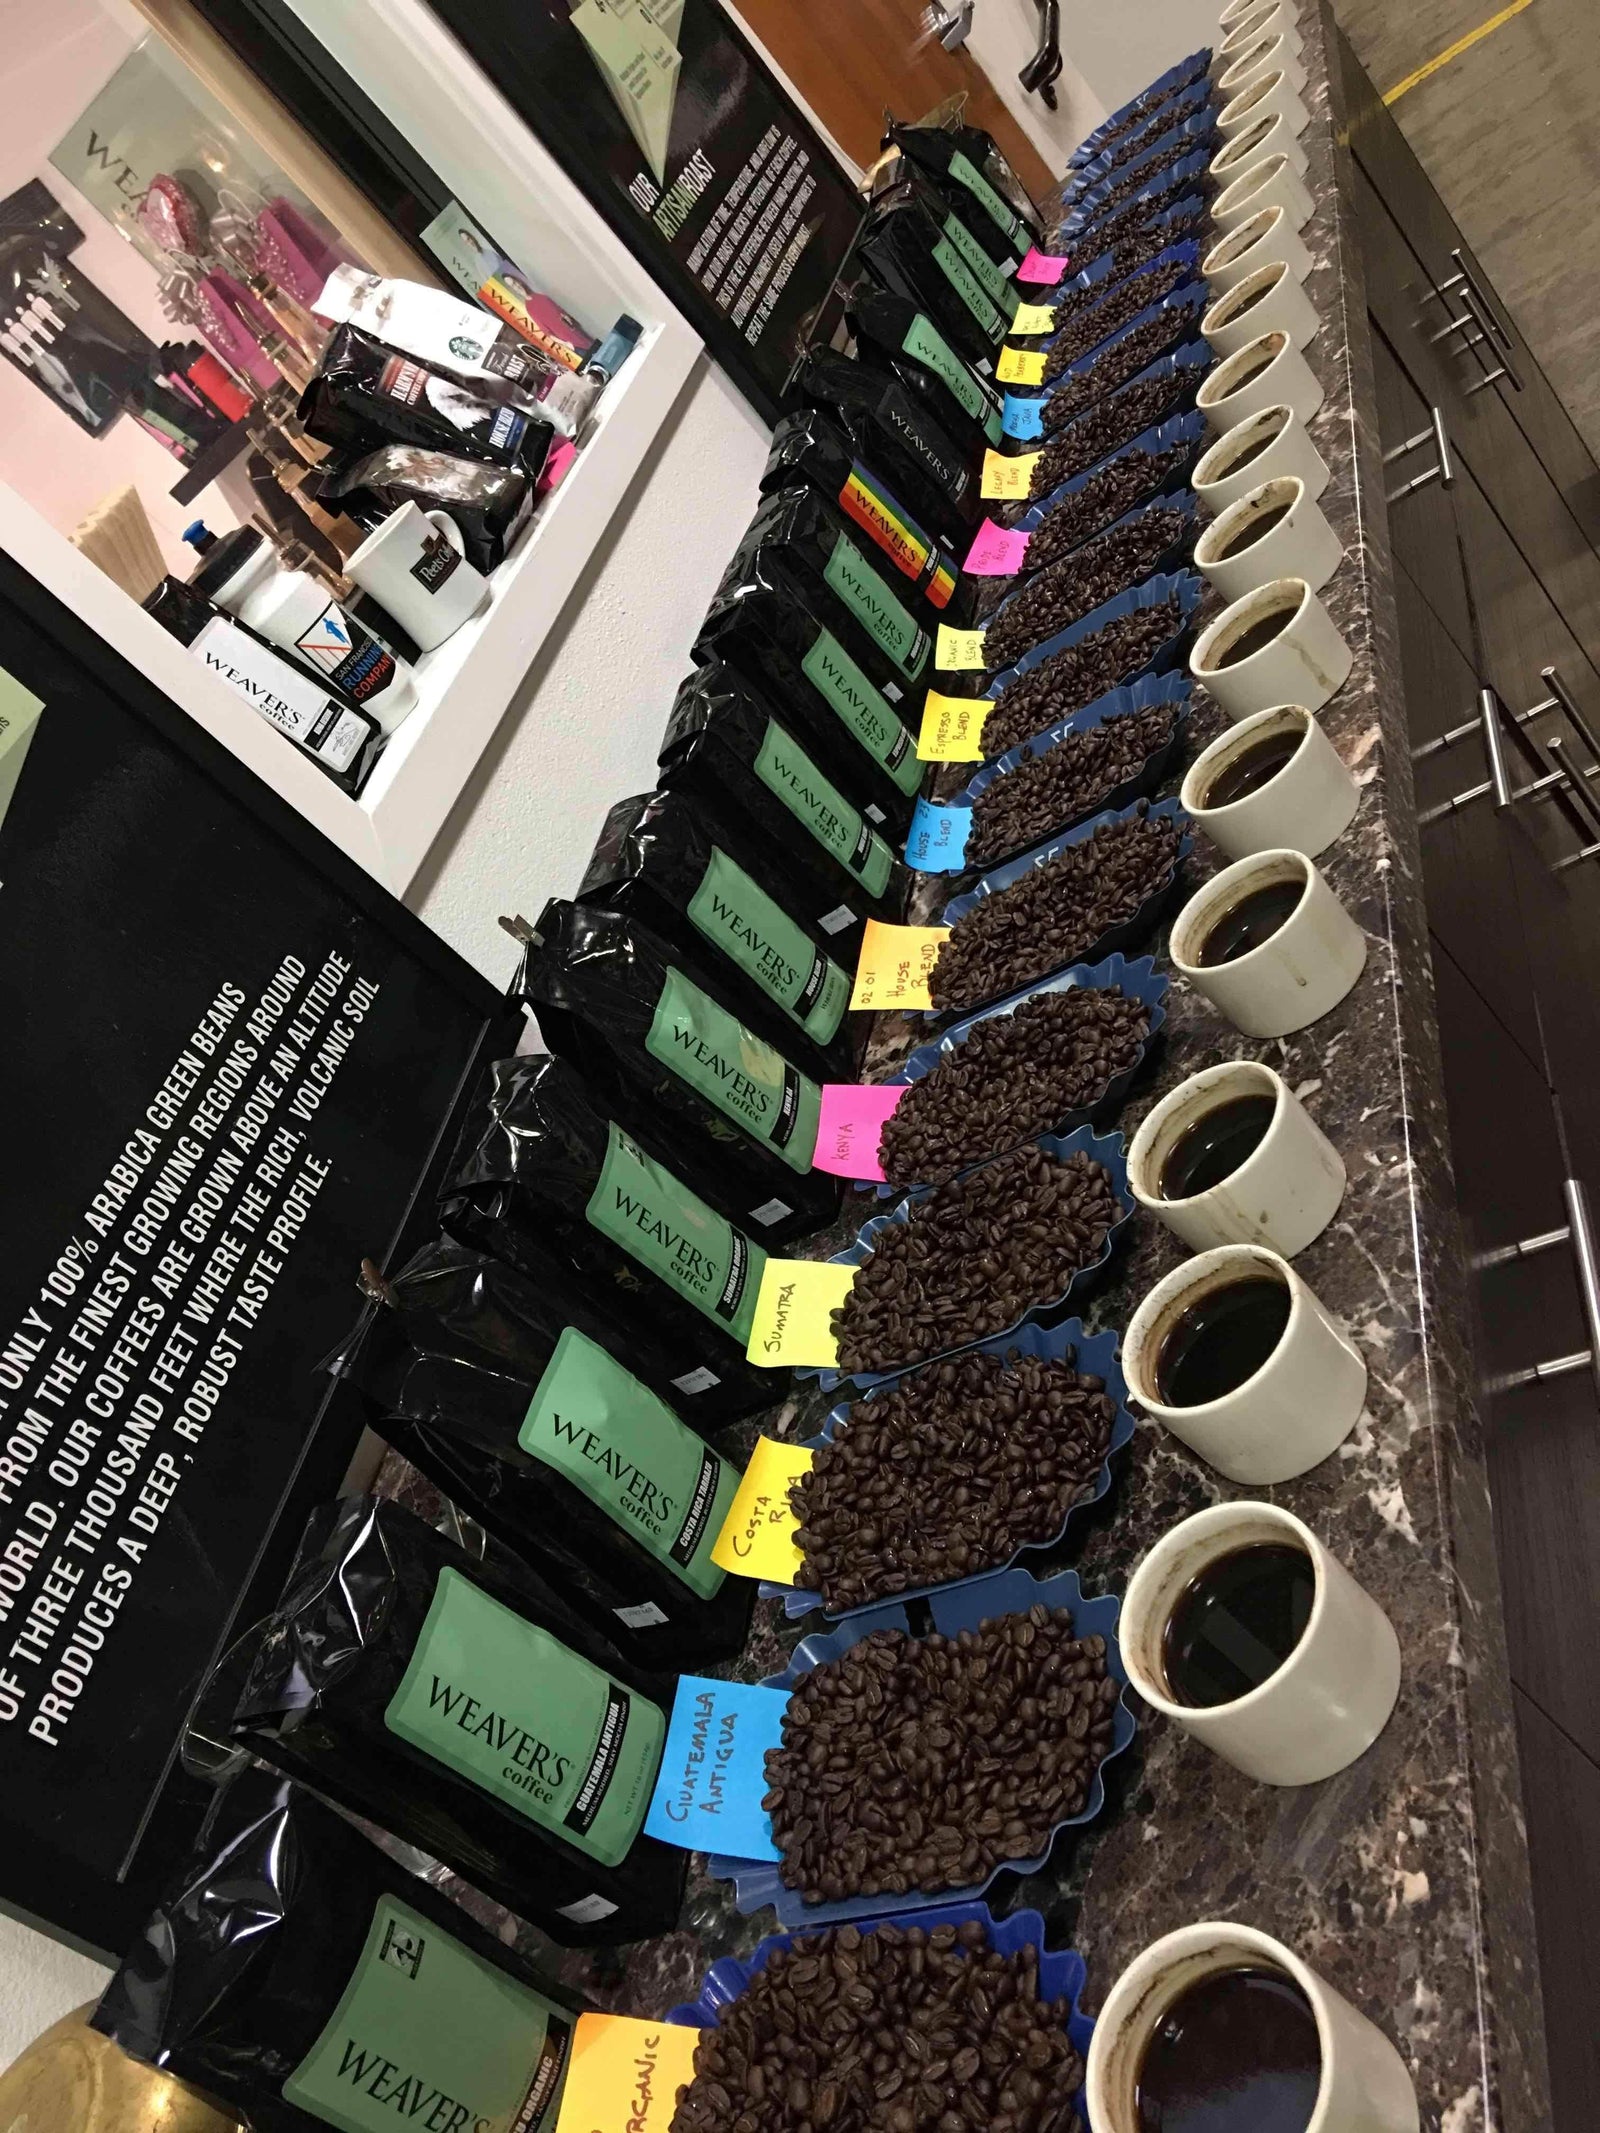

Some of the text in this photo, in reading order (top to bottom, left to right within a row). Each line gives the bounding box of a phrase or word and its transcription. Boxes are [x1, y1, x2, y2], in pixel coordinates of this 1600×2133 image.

[629, 172, 660, 213] OUR
[653, 148, 716, 242] ARTISANROAST
[742, 200, 757, 223] THE
[749, 172, 773, 212] POTENTIAL
[728, 211, 750, 247] UNLOCKS
[758, 198, 781, 235] BETWEEN
[716, 237, 735, 266] ROAST
[740, 224, 766, 268] DIFFERENCE
[784, 239, 801, 269] EVERY
[701, 268, 717, 292] HOW
[709, 256, 724, 279] OUR
[726, 269, 742, 291] THE
[730, 283, 757, 329] AUTOMATED
[766, 234, 783, 261] USED
[733, 257, 748, 279] KEY
[771, 257, 792, 295] PROCESS
[715, 287, 731, 311] THIS
[756, 300, 771, 325] THE
[762, 282, 780, 312] SAME
[744, 313, 765, 348] REPEAT
[504, 354, 527, 379] ROAST
[856, 490, 920, 563] WEAVER'S
[841, 565, 905, 645] WEAVER'S
[965, 639, 977, 662] BLEND
[205, 652, 304, 725] WEAVER'S
[335, 664, 352, 681] SAN
[259, 703, 295, 730] coffee
[821, 655, 889, 742] WEAVER'S
[855, 715, 880, 748] coffee
[930, 711, 951, 755] ESPRESSO
[952, 711, 971, 742] BLEND
[774, 757, 849, 843] WEAVER'S
[814, 817, 844, 849] coffee
[911, 831, 930, 861] HOUSE
[934, 818, 952, 848] BLEND
[711, 894, 800, 987] WEAVER'S
[756, 961, 788, 996] coffee
[805, 973, 818, 996] HOUSE
[886, 961, 911, 999] HOUSE
[911, 943, 936, 992] BLEND
[673, 1025, 773, 1114] WEAVER'S
[726, 1090, 763, 1125] coffee
[782, 1095, 793, 1116] KENYA
[830, 1122, 853, 1162] KENYA
[0, 982, 245, 1389] ONLY 100% ARABICA GREEN BEANS
[34, 1347, 86, 1406] THE
[69, 1252, 137, 1351] FINEST
[124, 1137, 204, 1255] GROWING
[189, 1040, 257, 1140] REGIONS
[246, 955, 305, 1045] AROUND
[49, 1419, 102, 1486] OUR
[86, 1297, 165, 1417] COFFEES
[151, 1240, 195, 1299] ARE
[180, 1148, 244, 1243] GROWN
[230, 1075, 283, 1154] ABOVE
[270, 1043, 300, 1082] AN
[288, 950, 350, 1050] ALTITUDE
[615, 1186, 720, 1284] WEAVER'S
[670, 1259, 708, 1296] coffee
[722, 1265, 739, 1303] SUMATRA
[764, 1283, 796, 1353] SUMATRA
[0, 1667, 26, 1720] OF
[14, 1556, 84, 1664] THREE
[64, 1394, 163, 1553] THOUSAND
[149, 1322, 198, 1393] FEET
[183, 1231, 246, 1324] WHERE
[230, 1183, 271, 1232] THE
[289, 1020, 354, 1121] VOLCANIC
[343, 977, 379, 1023] SOIL
[29, 1564, 132, 1746] PRODUCES
[117, 1537, 147, 1564] A
[173, 1328, 242, 1443] ROBUST
[227, 1250, 282, 1328] TASTE
[267, 1154, 332, 1253] PROFILE.
[552, 1412, 678, 1523] WEAVER'S
[620, 1495, 662, 1537] coffee
[679, 1460, 712, 1547] COSTA RICA TARRAZU
[733, 1496, 771, 1557] COSTA
[427, 1675, 577, 1788] WEAVER'S
[575, 1746, 609, 1812] GUATEMALA
[601, 1701, 620, 1748] ANTIGUA
[665, 1691, 716, 1822] GUATEMALA
[698, 1713, 738, 1815] ANTIGUA
[502, 1764, 554, 1805] coffee
[521, 2055, 554, 2120] ORGANIC
[626, 2035, 660, 2133] RGANIC
